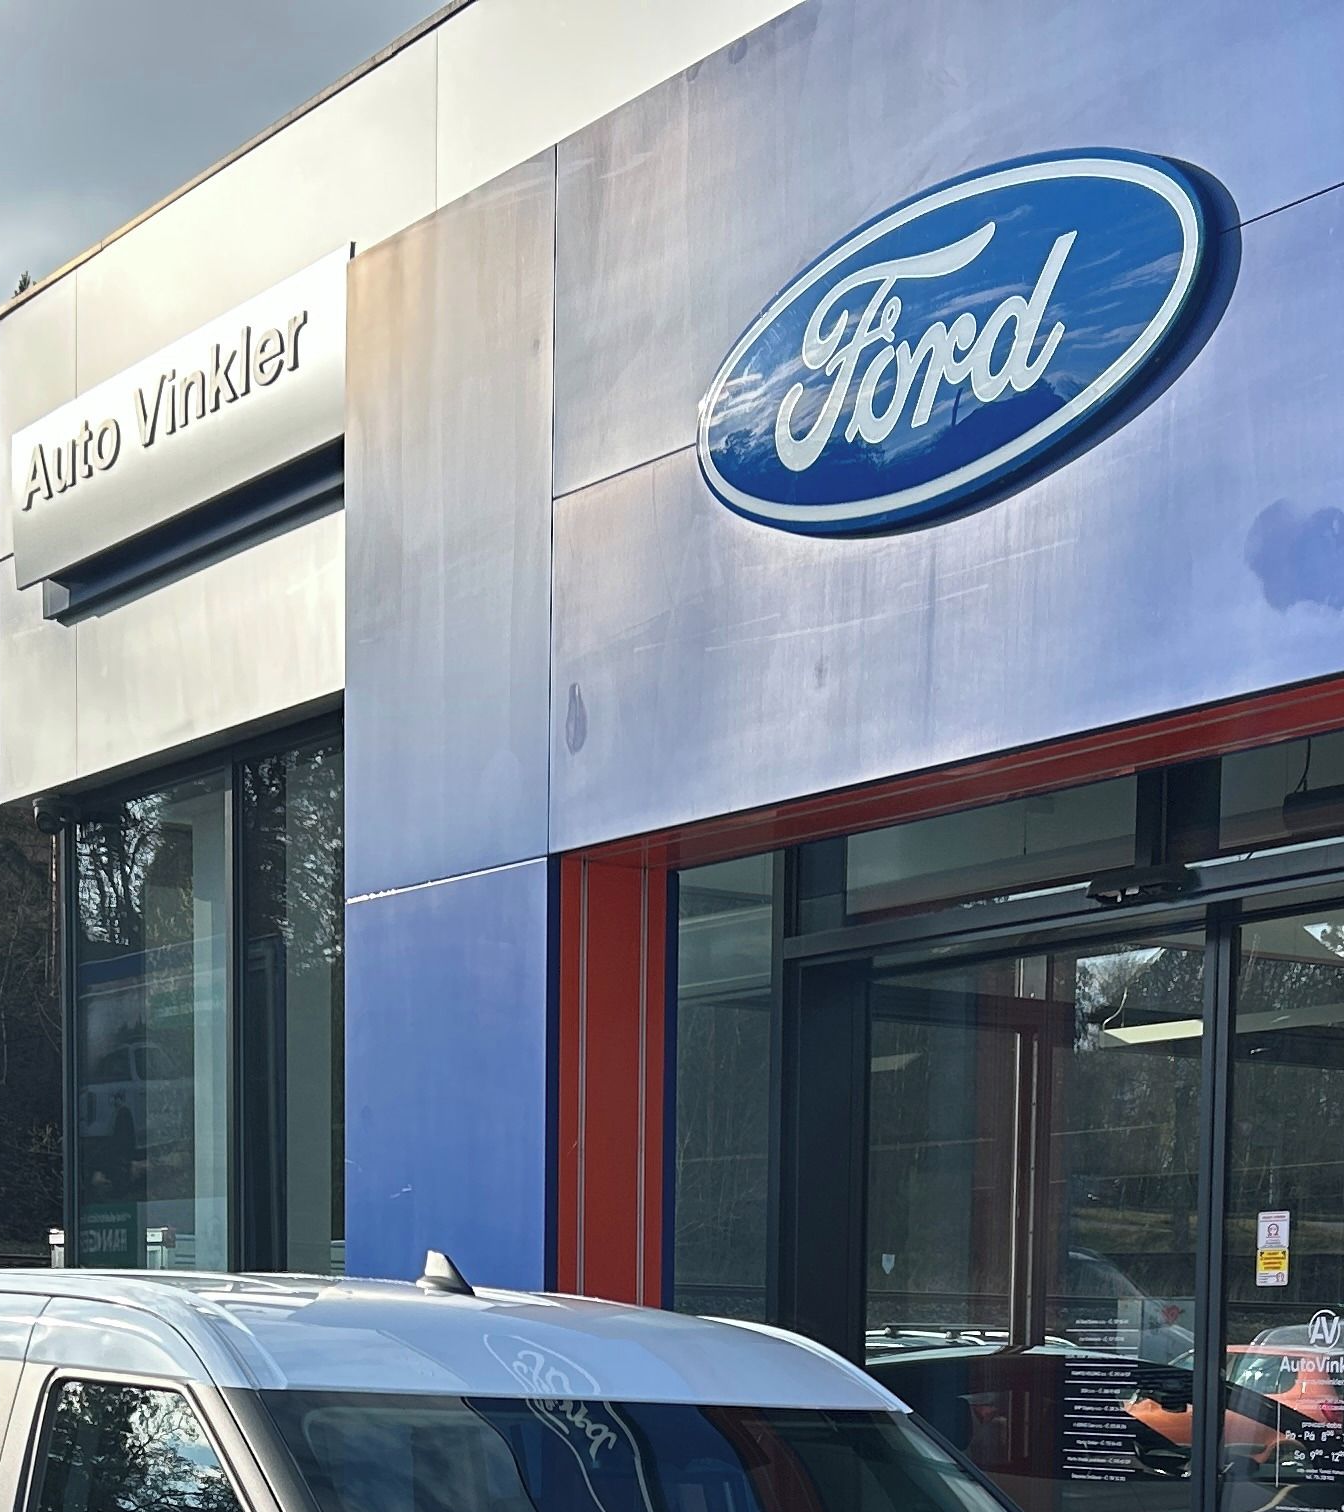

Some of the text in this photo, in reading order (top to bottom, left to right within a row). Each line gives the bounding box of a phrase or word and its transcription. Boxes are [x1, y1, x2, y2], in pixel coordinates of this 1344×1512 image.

[22, 310, 308, 511] Auto Vinkler
[774, 220, 1078, 472] Ford
